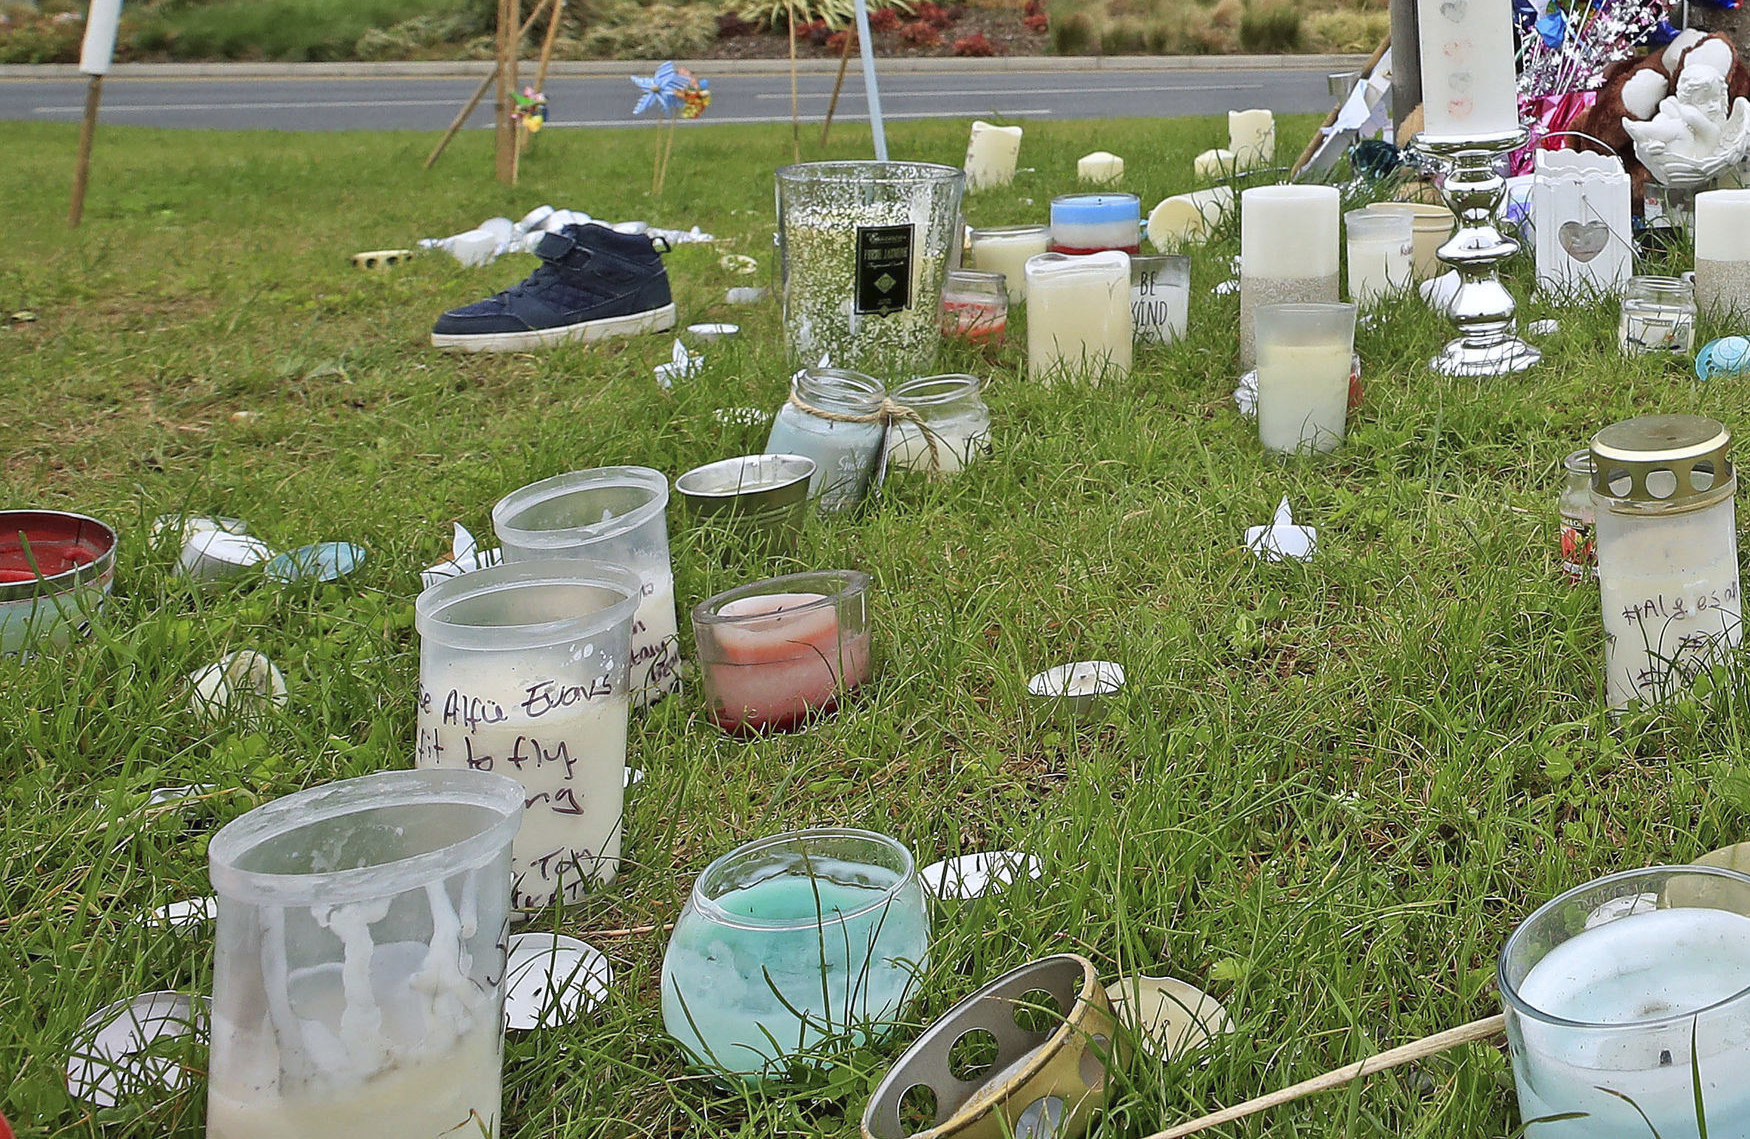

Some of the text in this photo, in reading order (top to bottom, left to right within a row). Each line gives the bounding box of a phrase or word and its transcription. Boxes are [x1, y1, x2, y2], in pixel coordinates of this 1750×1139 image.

[1140, 270, 1157, 296] BE
[1131, 300, 1168, 326] KIND
[443, 689, 508, 734] Alfie
[521, 674, 612, 717] Evans
[464, 736, 494, 771] to
[507, 736, 578, 780] fly
